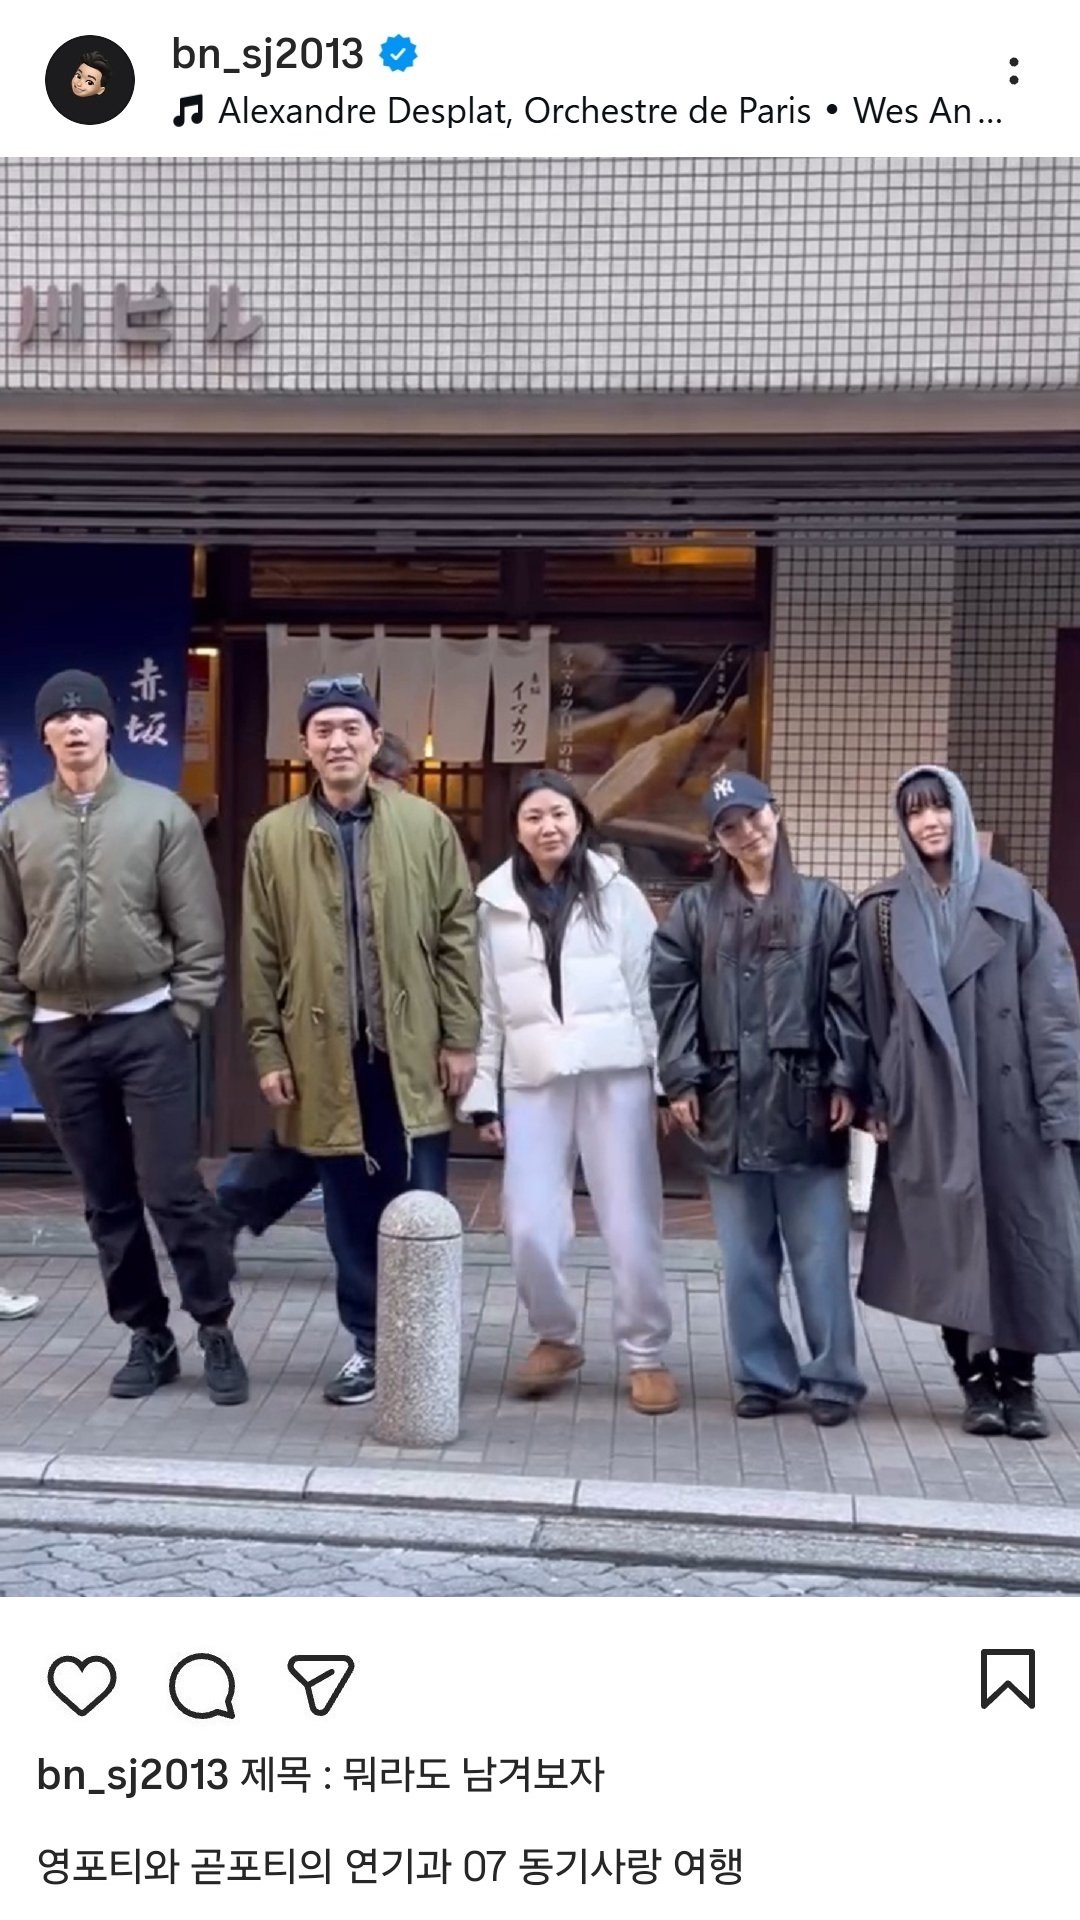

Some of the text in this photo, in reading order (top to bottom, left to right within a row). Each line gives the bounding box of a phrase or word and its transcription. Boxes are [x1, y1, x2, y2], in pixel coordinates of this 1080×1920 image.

[18, 282, 263, 345] 川ビル
[124, 656, 169, 746] 赤坂
[510, 680, 528, 755] イマカツ
